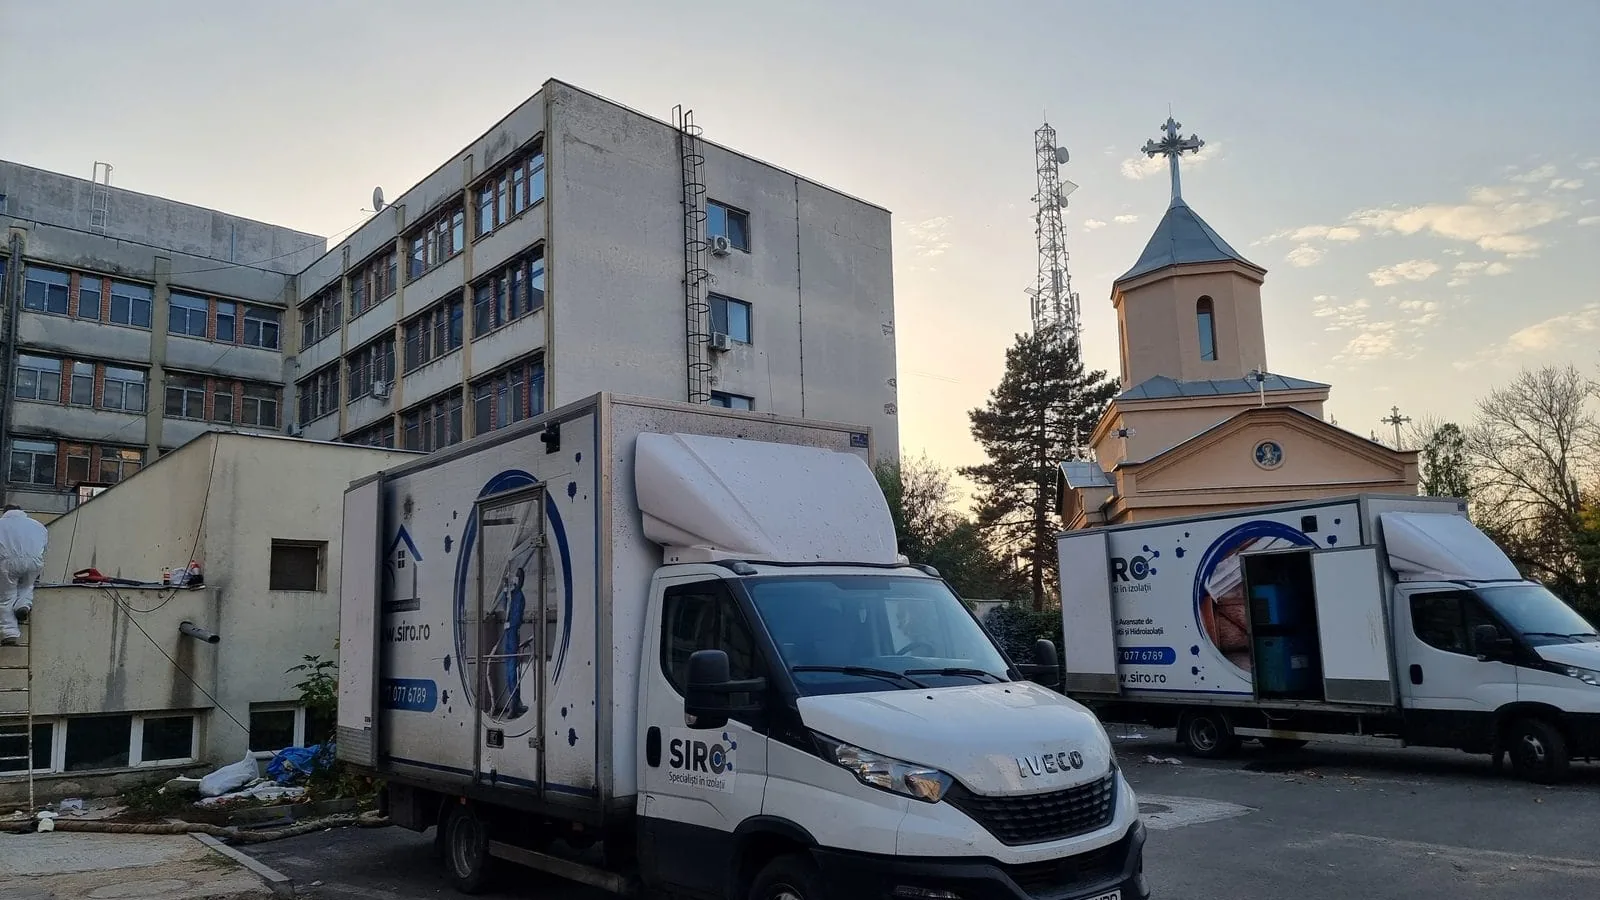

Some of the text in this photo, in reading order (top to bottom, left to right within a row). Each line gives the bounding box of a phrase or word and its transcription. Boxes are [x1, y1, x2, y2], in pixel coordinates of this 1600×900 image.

[1145, 617, 1153, 625] de
[1124, 650, 1139, 661] 077
[1141, 650, 1163, 661] 6789
[392, 685, 407, 703] 077
[407, 687, 427, 704] 6789
[669, 738, 727, 775] SIRO
[1015, 750, 1084, 778] IVECO
